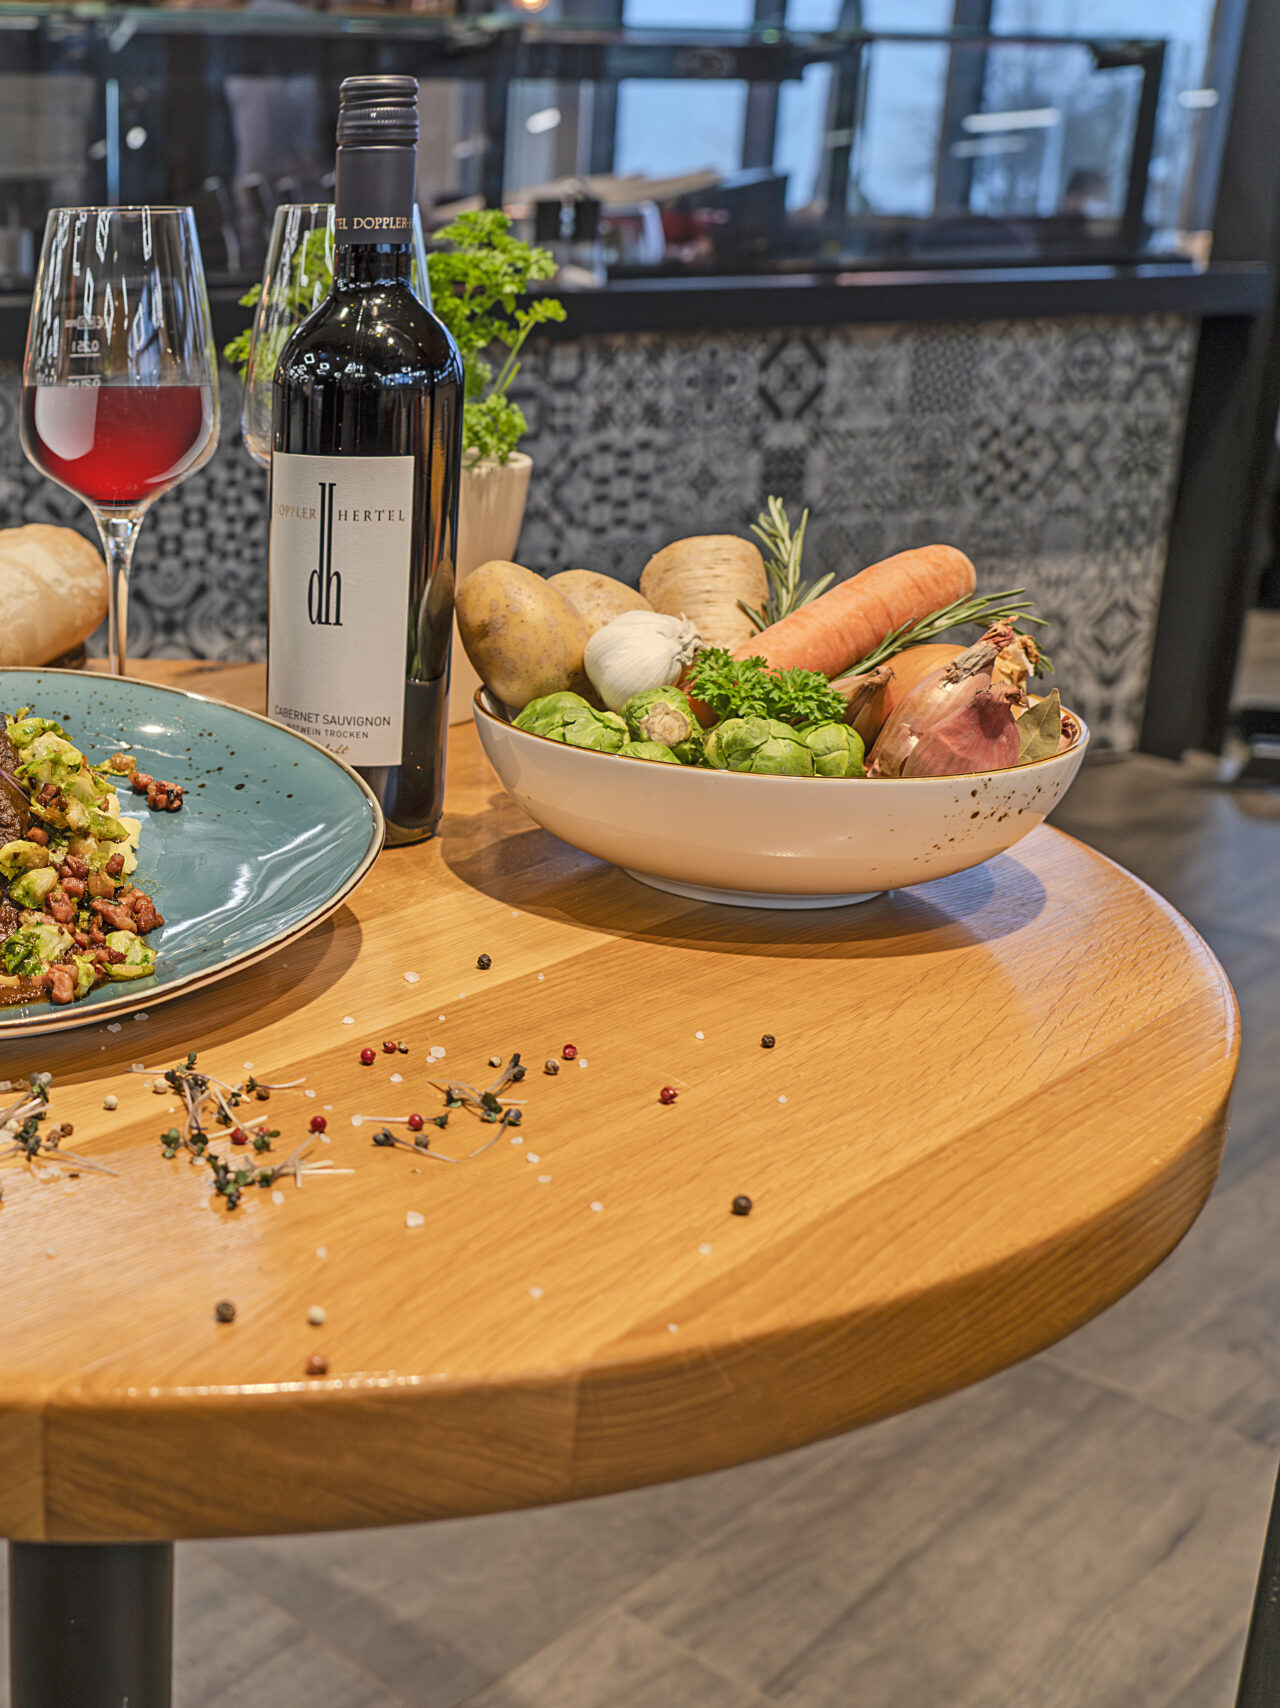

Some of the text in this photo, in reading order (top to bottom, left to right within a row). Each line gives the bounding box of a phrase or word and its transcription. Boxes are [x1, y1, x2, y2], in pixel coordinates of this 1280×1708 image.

[338, 509, 405, 522] HERTEL
[274, 704, 391, 727] CABERNET SAUVIGNON
[325, 729, 369, 739] TROCKEN
